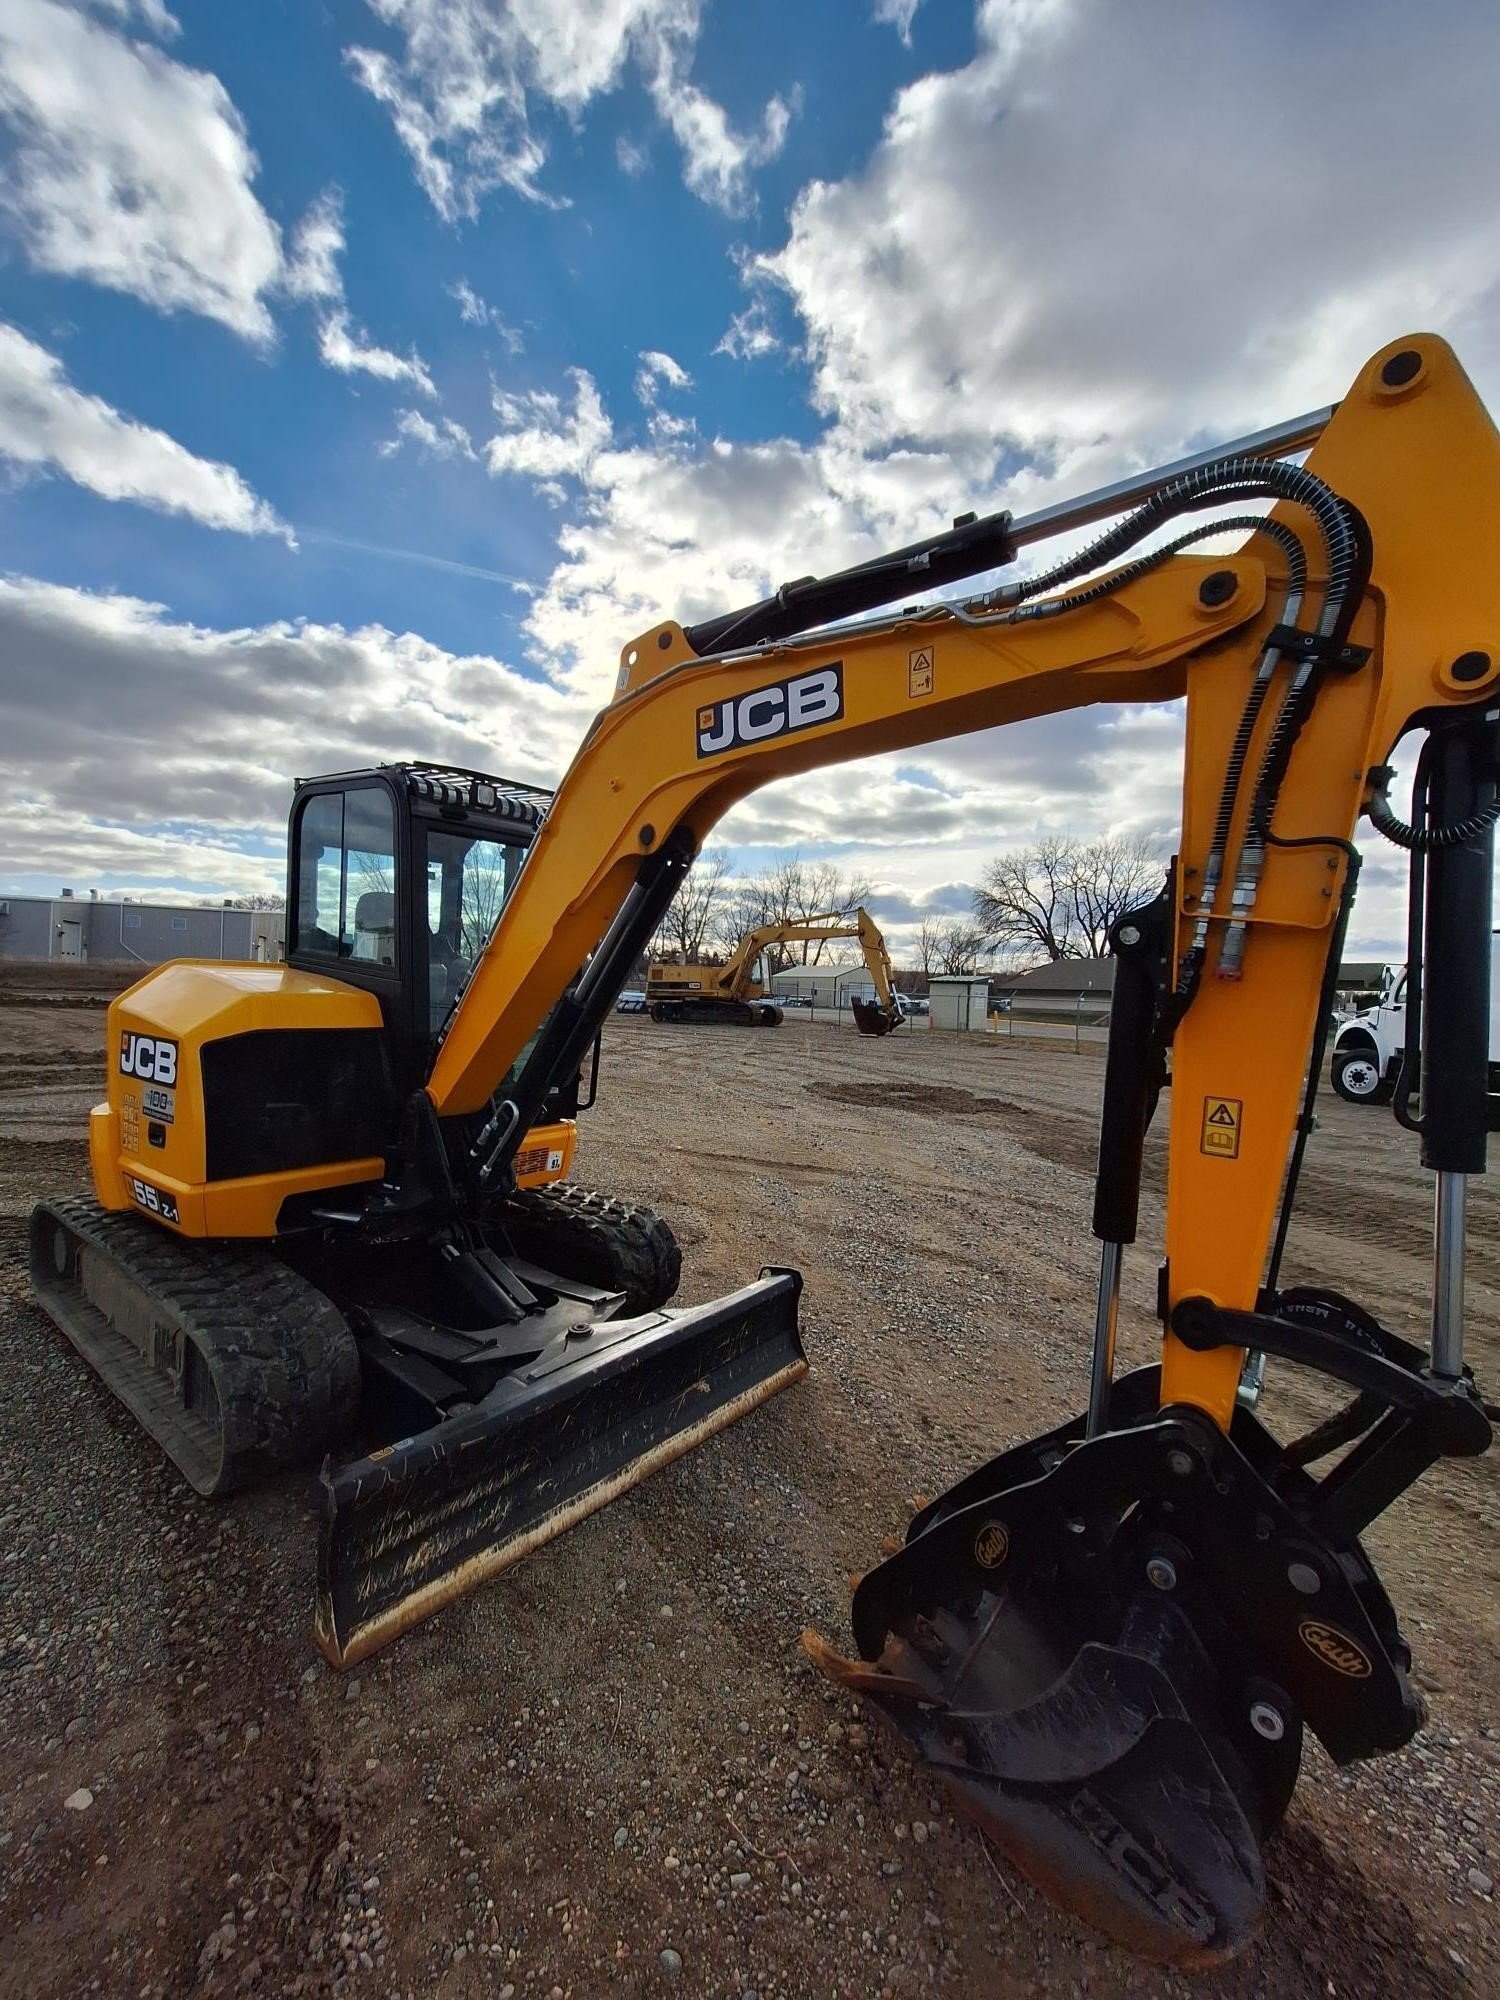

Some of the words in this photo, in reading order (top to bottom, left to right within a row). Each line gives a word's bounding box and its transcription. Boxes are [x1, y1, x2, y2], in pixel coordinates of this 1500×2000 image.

[699, 670, 841, 752] JCB
[121, 1035, 177, 1084] JCB
[133, 1179, 159, 1211] 55
